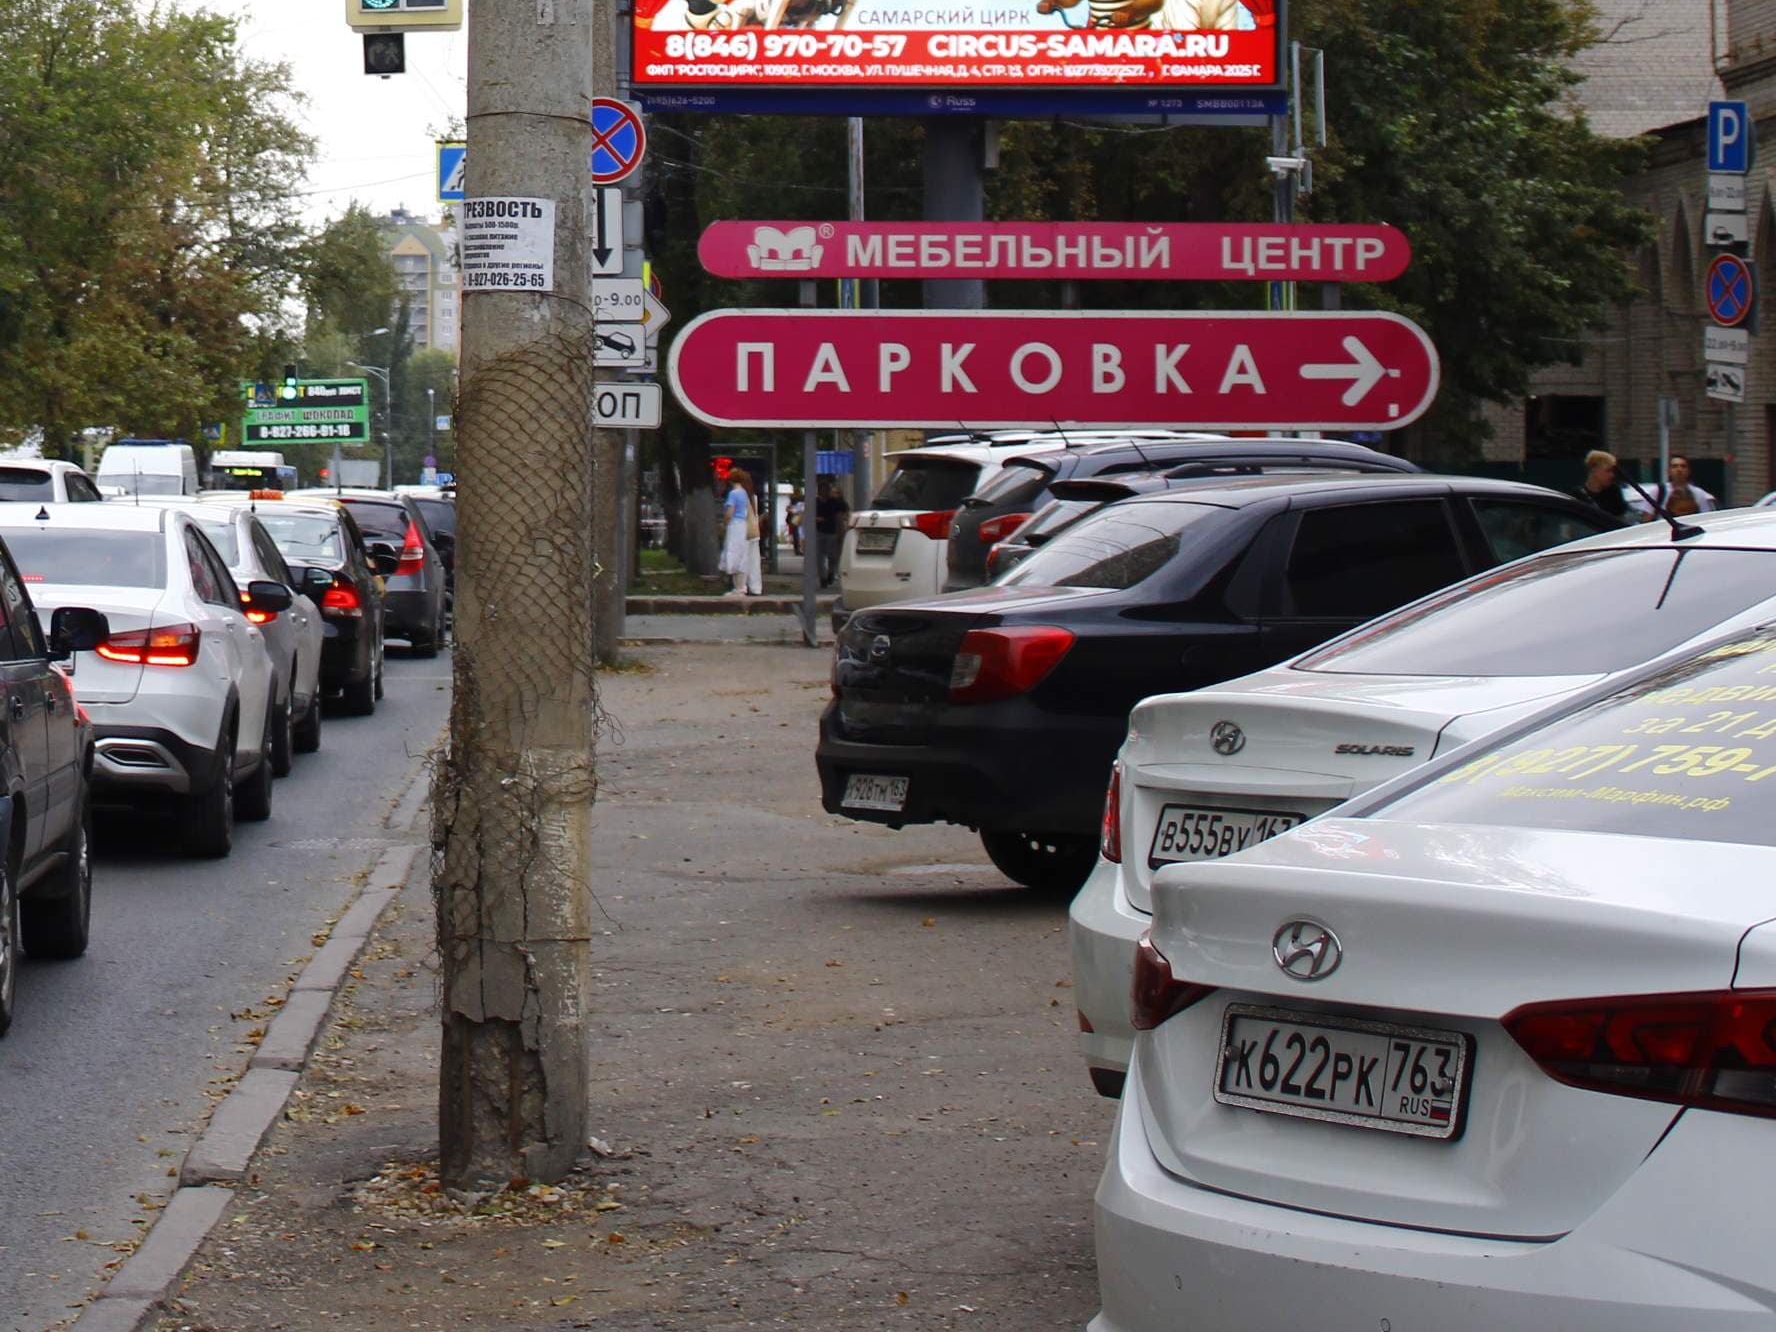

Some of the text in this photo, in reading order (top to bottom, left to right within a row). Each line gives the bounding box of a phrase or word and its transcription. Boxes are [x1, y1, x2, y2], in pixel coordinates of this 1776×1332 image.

[857, 5, 1031, 28] САМАРСКИЙ ЦИРК
[665, 32, 907, 61] 8(846) 970-70-57
[927, 34, 1230, 59] CIRCUS-SAMARA.RU
[645, 63, 675, 77] ФКП
[812, 63, 864, 79] МОСКВА,
[845, 227, 1386, 277] МЕБЕЛЬНЫЙ ЦЕНТР
[735, 341, 1267, 395] ПАРКОВКА
[1334, 743, 1416, 757] SOLARIS
[1161, 812, 1253, 857] В555ВУ
[1234, 1029, 1454, 1108] К622РК 763
[1399, 1096, 1430, 1118] RUS
